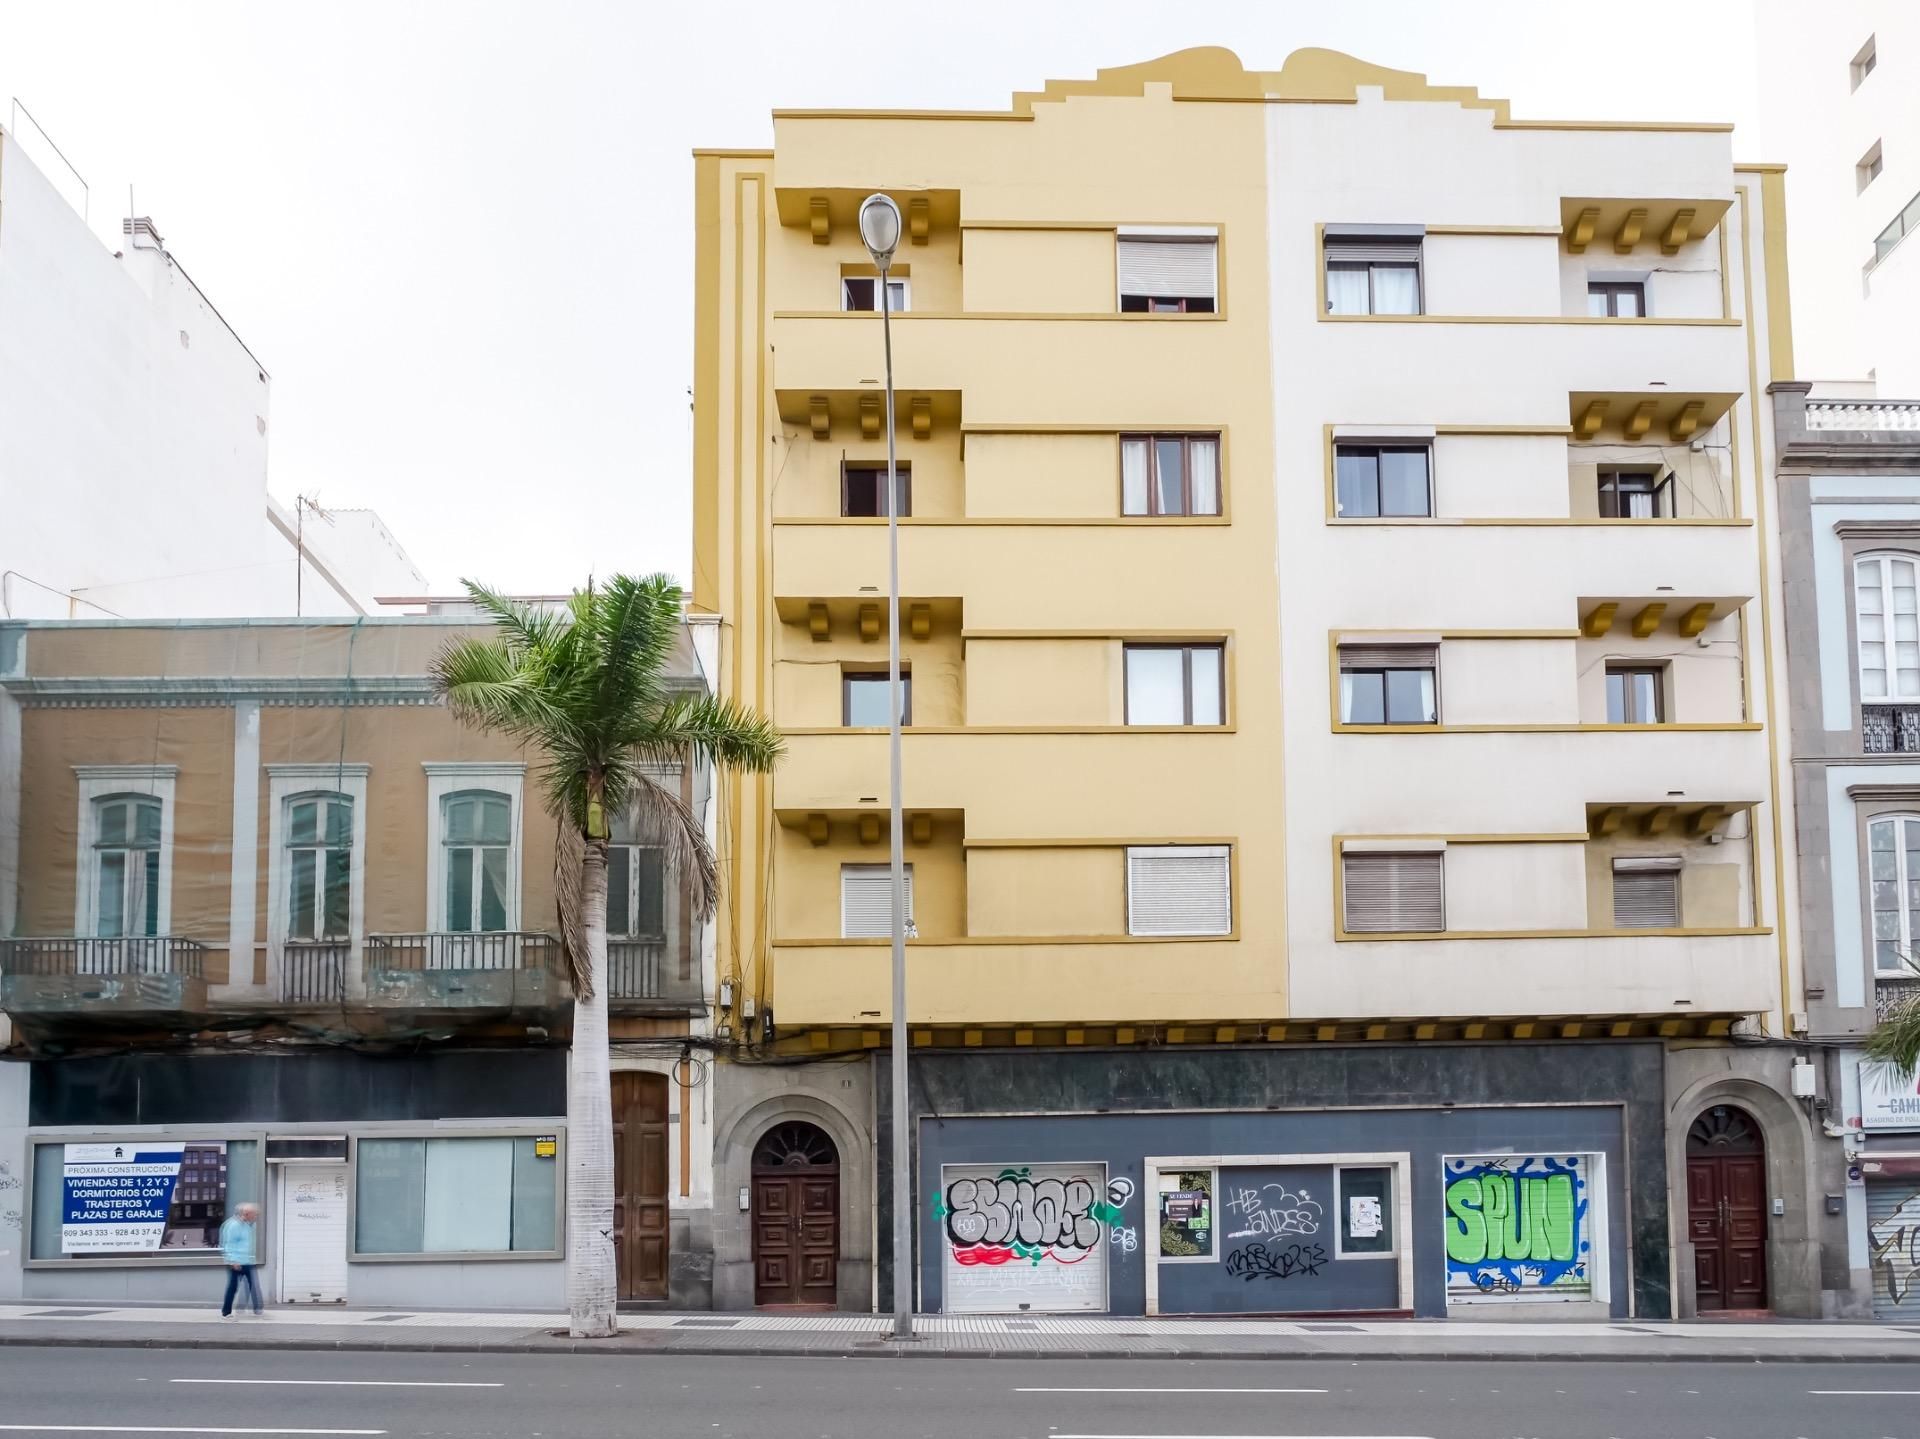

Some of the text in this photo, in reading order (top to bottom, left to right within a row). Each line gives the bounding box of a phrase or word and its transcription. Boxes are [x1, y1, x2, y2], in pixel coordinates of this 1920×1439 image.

[68, 1164, 174, 1174] PRÓXIMA CONSTRUCCIÓN
[68, 1178, 170, 1187] VIVIENDAS DE 1, 2 Y 3
[73, 1189, 164, 1198] DORMITORIOS CON
[85, 1200, 142, 1208] TRASTEROS
[71, 1210, 164, 1219] PLAZAS DE GARAJE
[64, 1229, 77, 1237] 609
